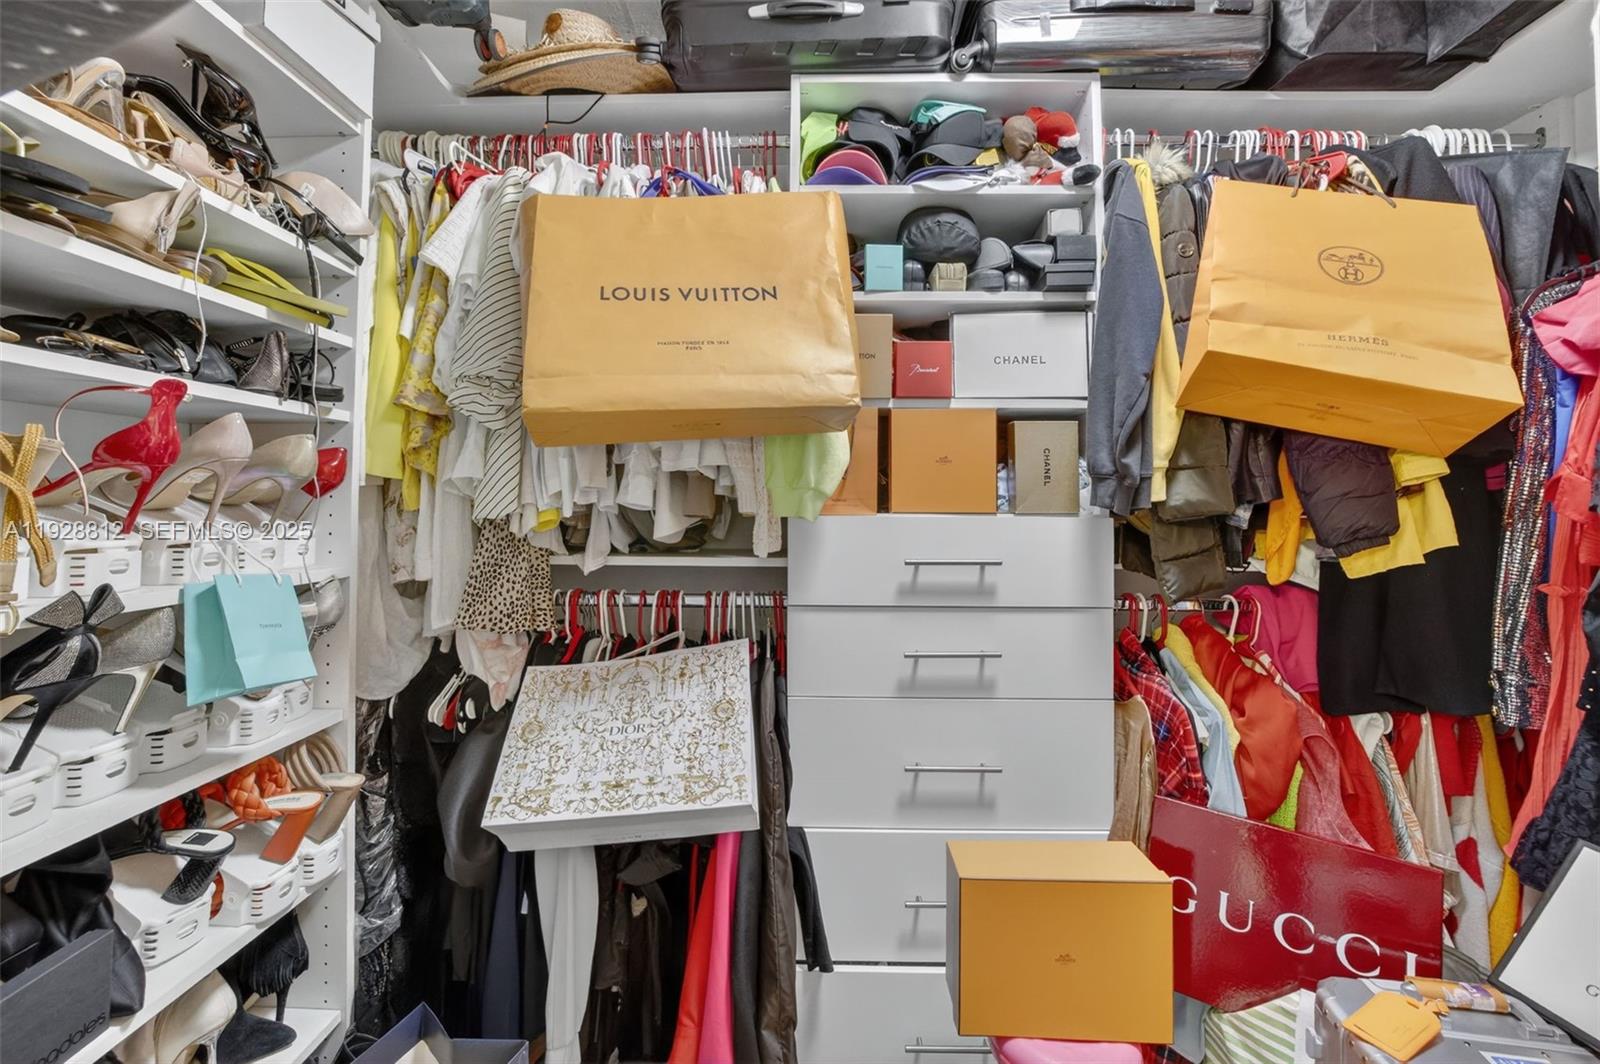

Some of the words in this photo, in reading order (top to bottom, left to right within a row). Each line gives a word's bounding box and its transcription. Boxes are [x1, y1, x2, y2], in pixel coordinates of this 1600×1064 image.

[600, 286, 670, 301] LOUIS
[678, 286, 778, 301] VUITTON
[993, 355, 1046, 365] CHANEL
[1043, 447, 1051, 487] CHANEL
[609, 724, 646, 736] DIOR
[1169, 876, 1418, 977] GUCCI
